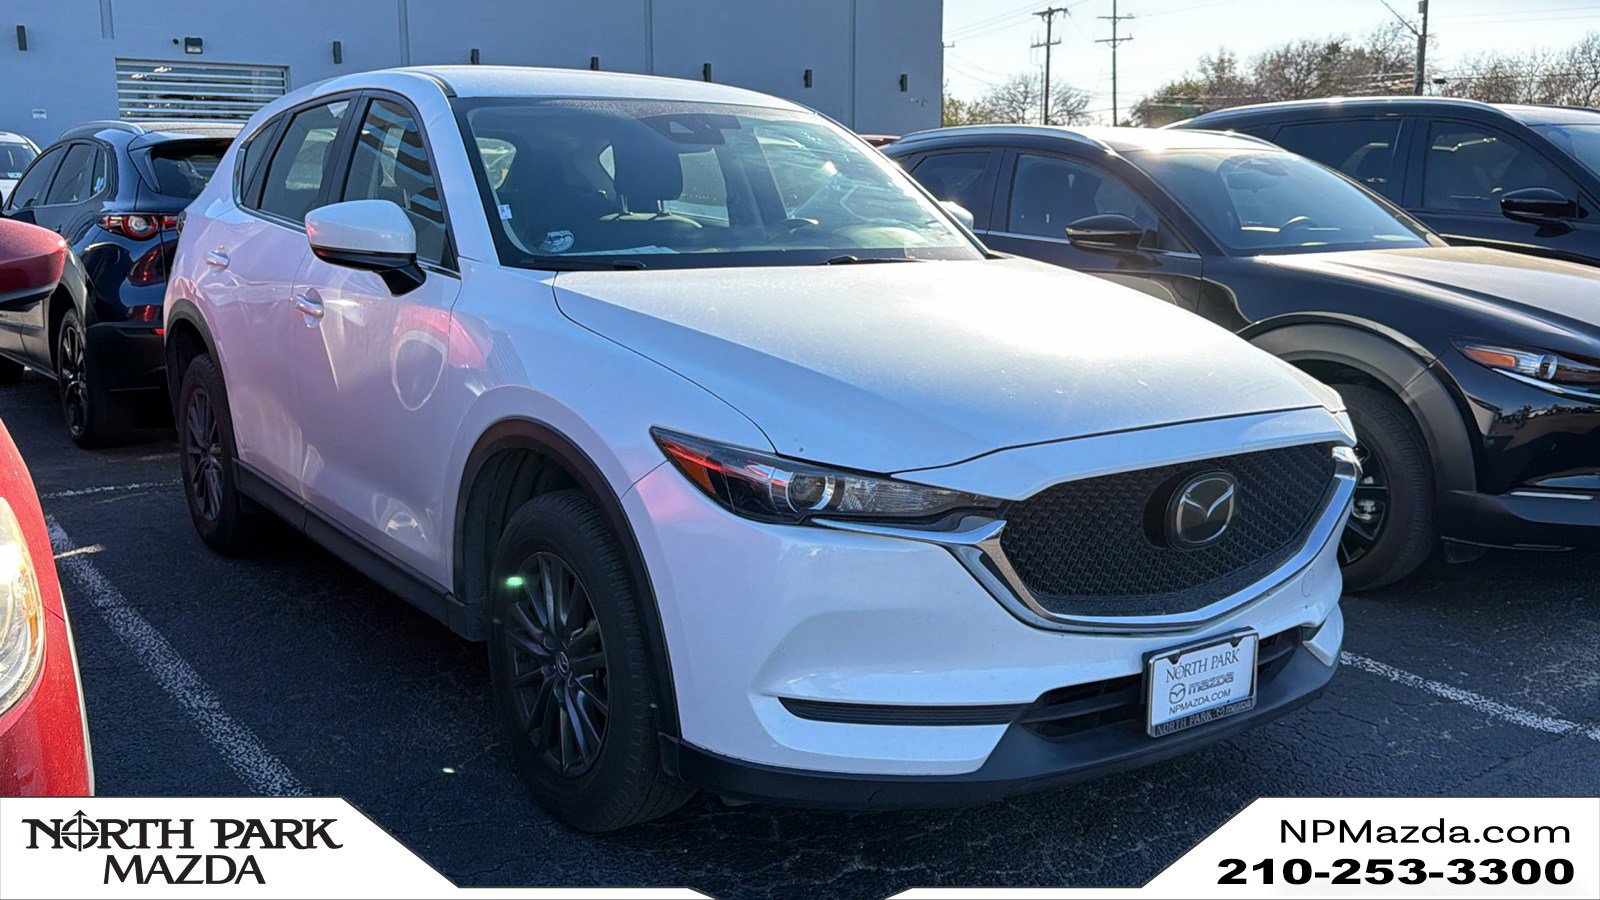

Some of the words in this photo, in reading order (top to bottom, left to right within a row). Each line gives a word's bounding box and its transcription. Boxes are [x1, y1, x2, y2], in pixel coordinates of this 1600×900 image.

[1166, 658, 1208, 683] NORTH
[1211, 649, 1240, 669] PARK
[1188, 672, 1234, 695] mazda
[1169, 689, 1231, 715] NPMAZDA.COM
[1155, 715, 1188, 736] NORTH
[1189, 711, 1213, 727] PARK
[1225, 699, 1252, 714] mazda
